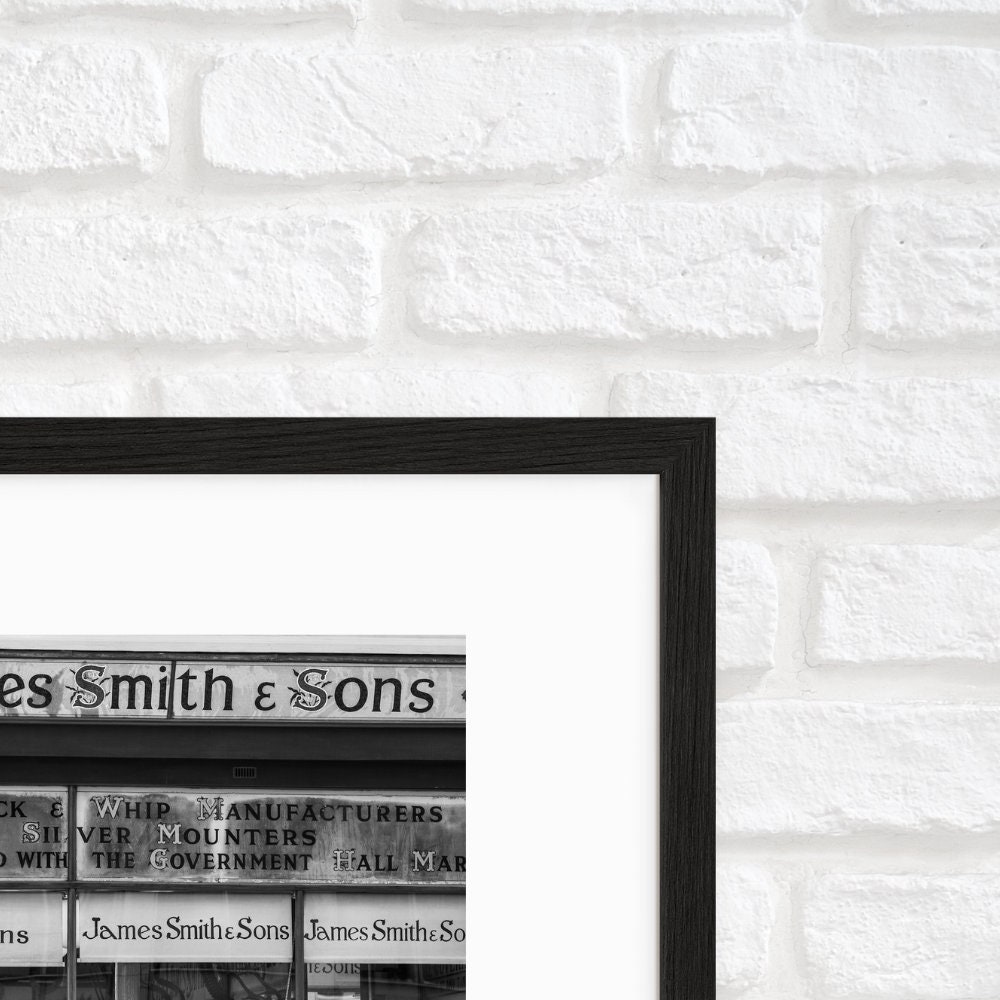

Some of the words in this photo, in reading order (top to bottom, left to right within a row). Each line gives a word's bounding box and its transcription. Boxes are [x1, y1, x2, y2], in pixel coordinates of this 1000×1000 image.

[68, 665, 233, 711] Smith
[289, 668, 435, 714] Sons
[90, 795, 171, 819] WHIP
[197, 796, 443, 823] MANUFACTURERS
[157, 822, 316, 846] MOUNTERS
[16, 851, 69, 869] WITH
[92, 851, 135, 869] THE
[149, 848, 313, 871] GOVERNMENT
[333, 848, 400, 872] HALL
[82, 916, 171, 941] James
[166, 916, 223, 941] Smith
[236, 916, 289, 941] Sons
[304, 918, 369, 941] James
[371, 919, 428, 943] Smith
